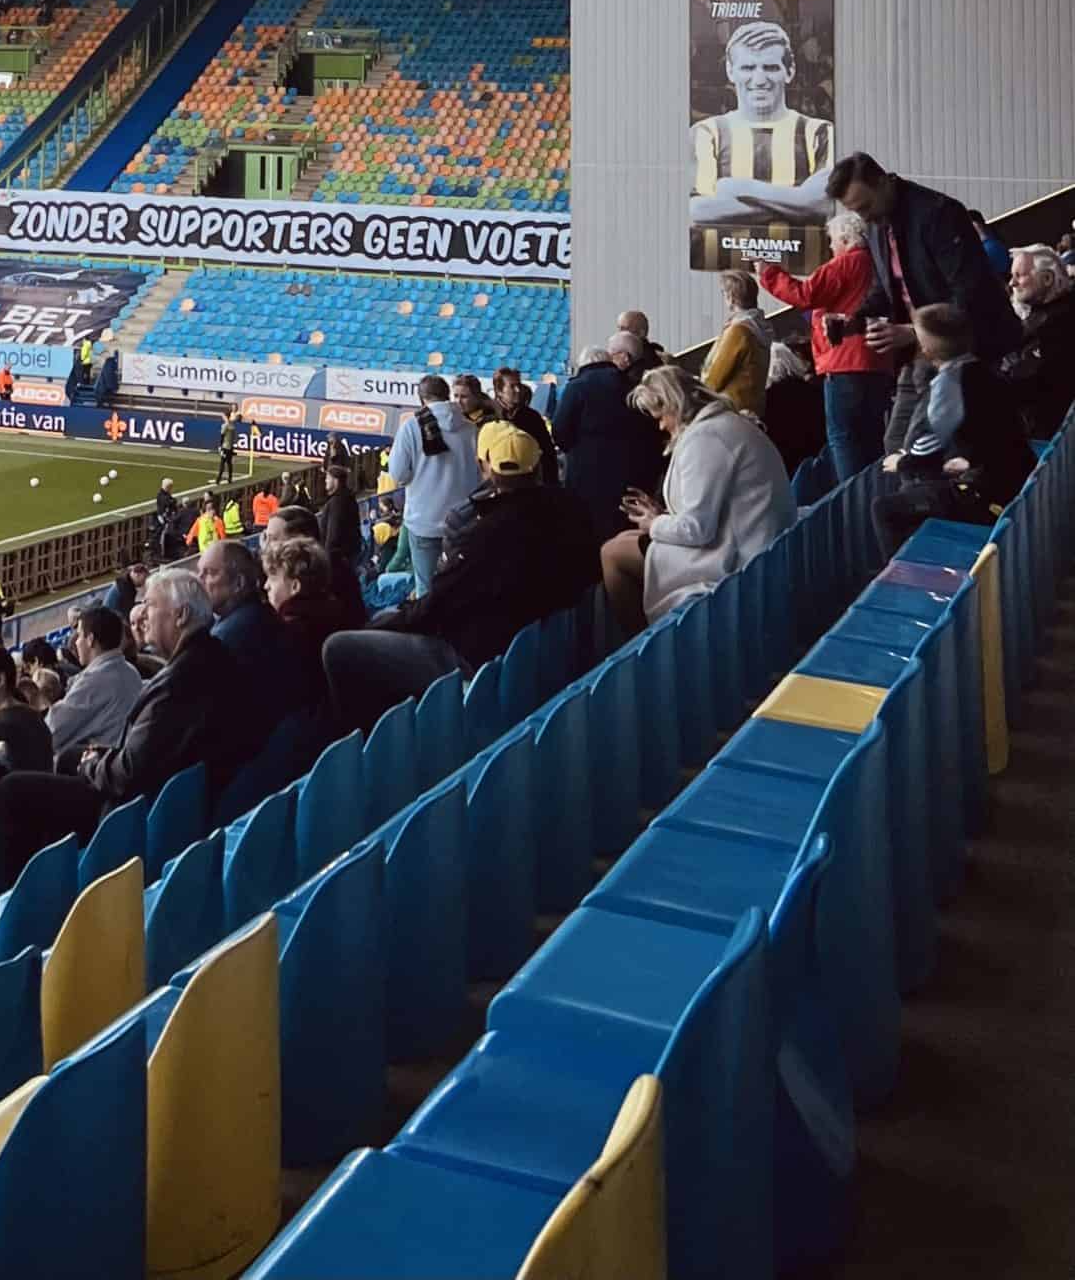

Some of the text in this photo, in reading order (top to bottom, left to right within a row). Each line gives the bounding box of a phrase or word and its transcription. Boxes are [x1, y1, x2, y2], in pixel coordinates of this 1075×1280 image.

[710, 2, 763, 19] TRIBUNE
[8, 202, 127, 243] ZONDER
[138, 205, 354, 254] SUPPORTERS
[362, 218, 453, 259] GEEN
[721, 237, 802, 252] CLEANMAT
[741, 250, 782, 260] TRUCKS
[2, 304, 92, 326] BET
[157, 362, 302, 390] summio parcs
[247, 403, 302, 419] ABCO
[325, 410, 380, 426] ABCO
[32, 413, 65, 431] van
[129, 418, 185, 443] LAVG
[233, 430, 326, 456] andelijke
